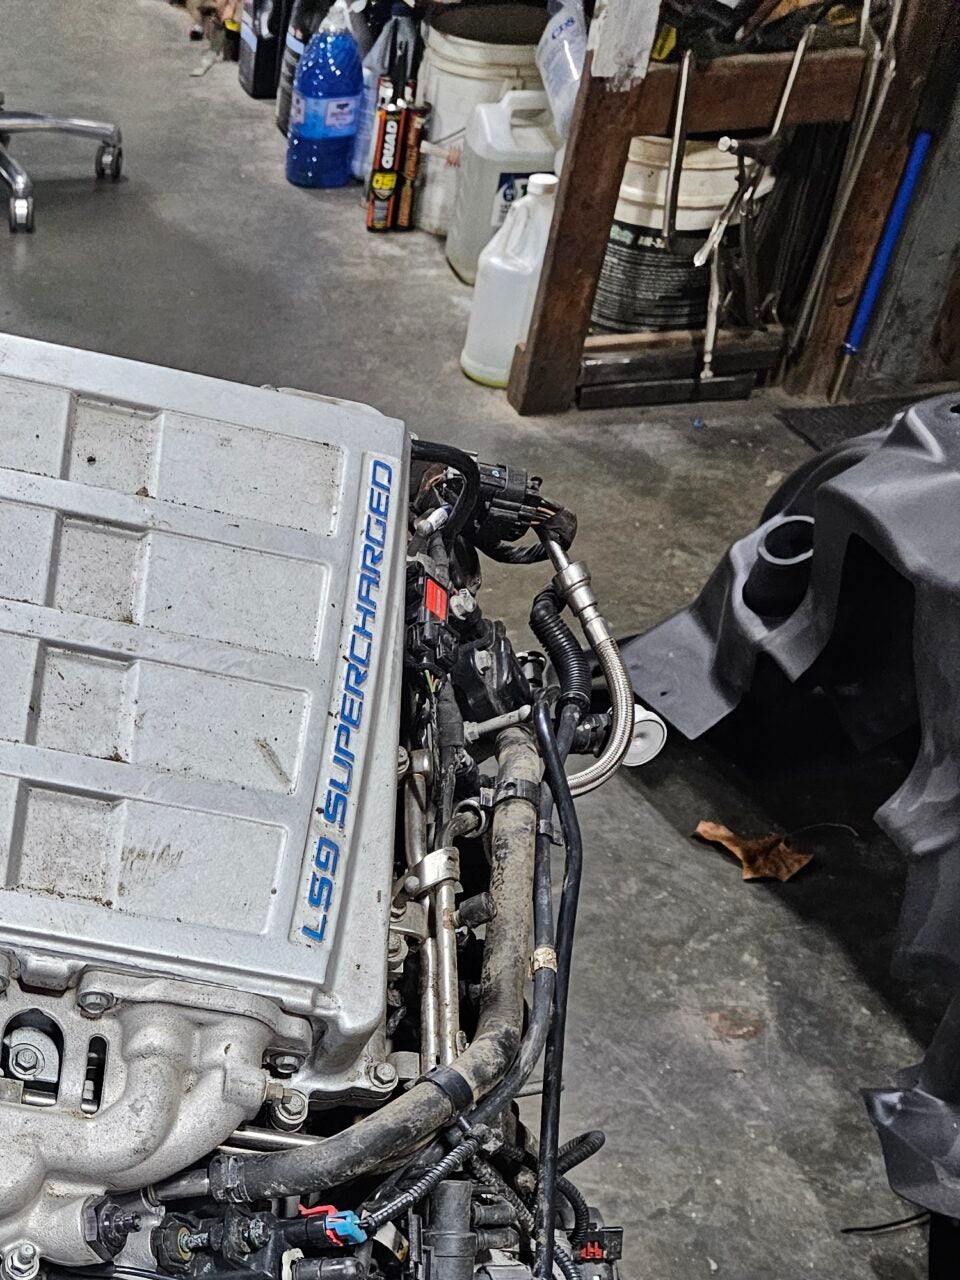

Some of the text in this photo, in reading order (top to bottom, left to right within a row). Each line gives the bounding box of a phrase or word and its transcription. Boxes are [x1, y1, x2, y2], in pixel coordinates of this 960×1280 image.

[381, 120, 398, 169] QUAD
[301, 459, 393, 943] LS9 SUPERCHARGED
